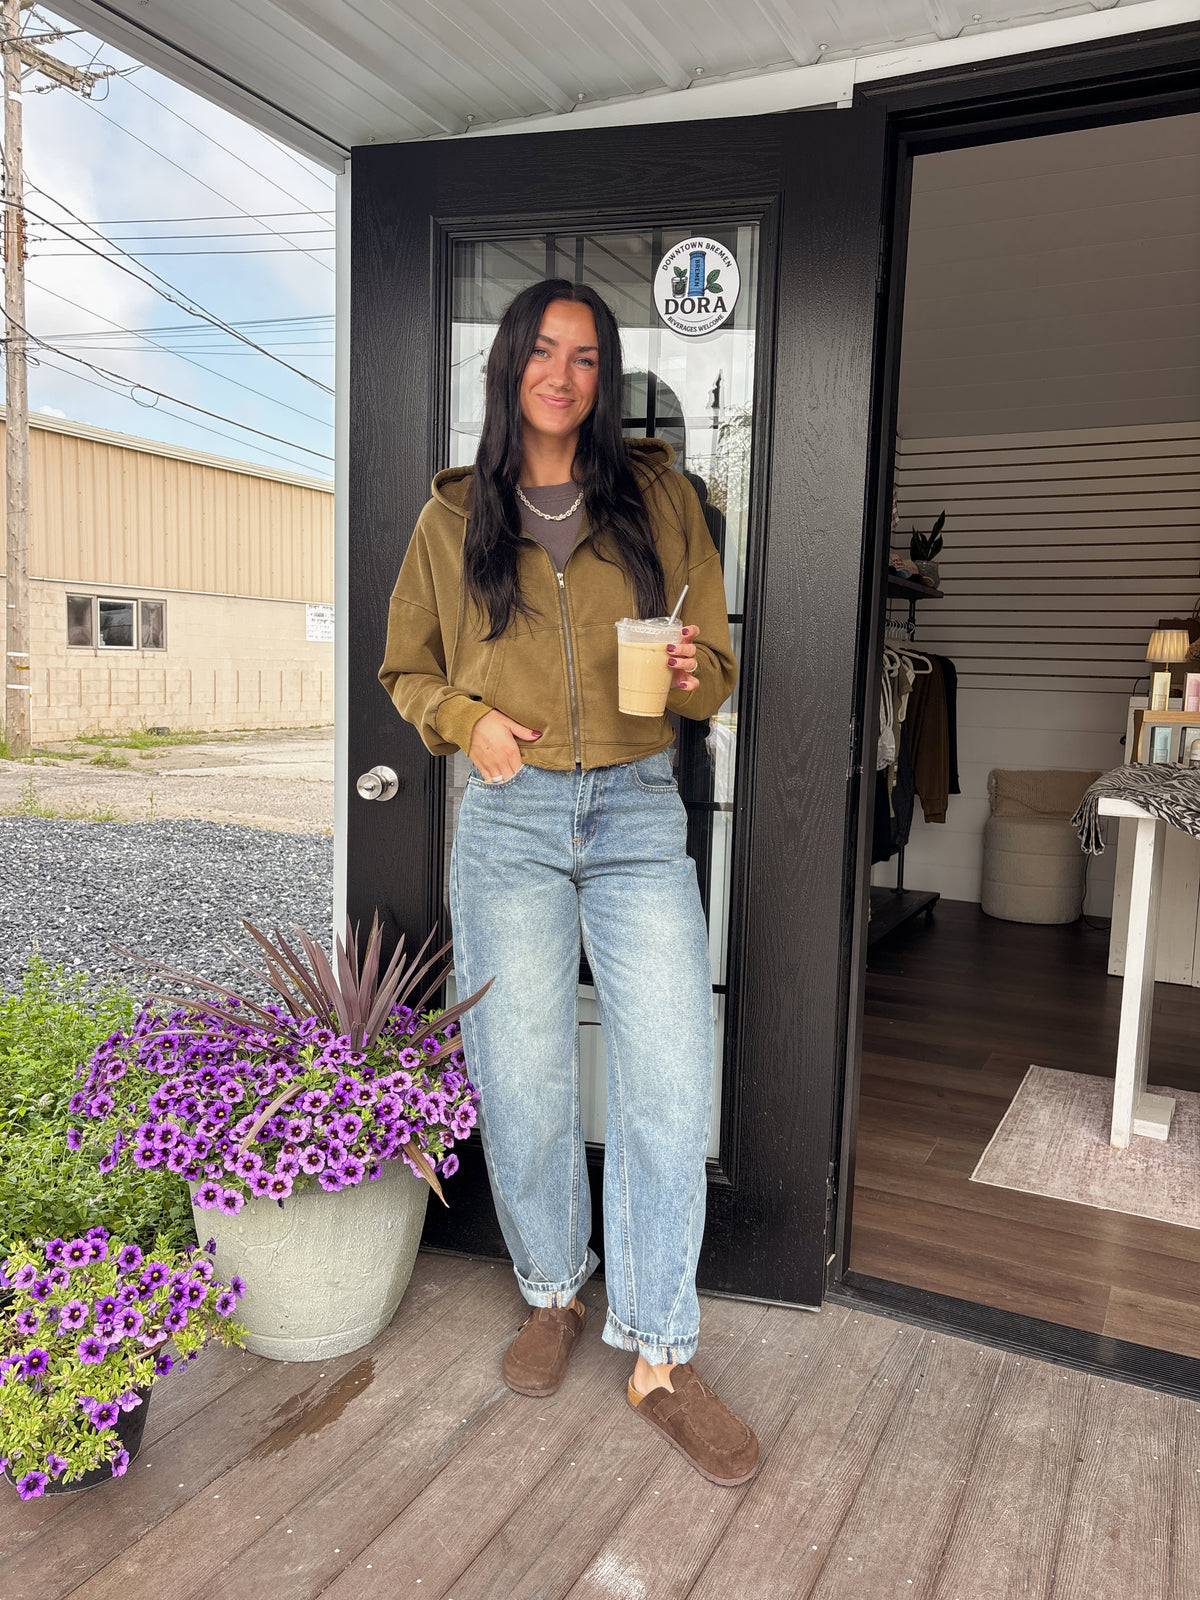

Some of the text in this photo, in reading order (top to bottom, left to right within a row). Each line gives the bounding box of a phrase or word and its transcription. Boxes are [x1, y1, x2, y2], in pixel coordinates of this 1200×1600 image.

[662, 241, 732, 271] DOWNTOWN BREMEN
[664, 296, 727, 315] DORA
[667, 314, 724, 332] BEVERAGES WELCOME
